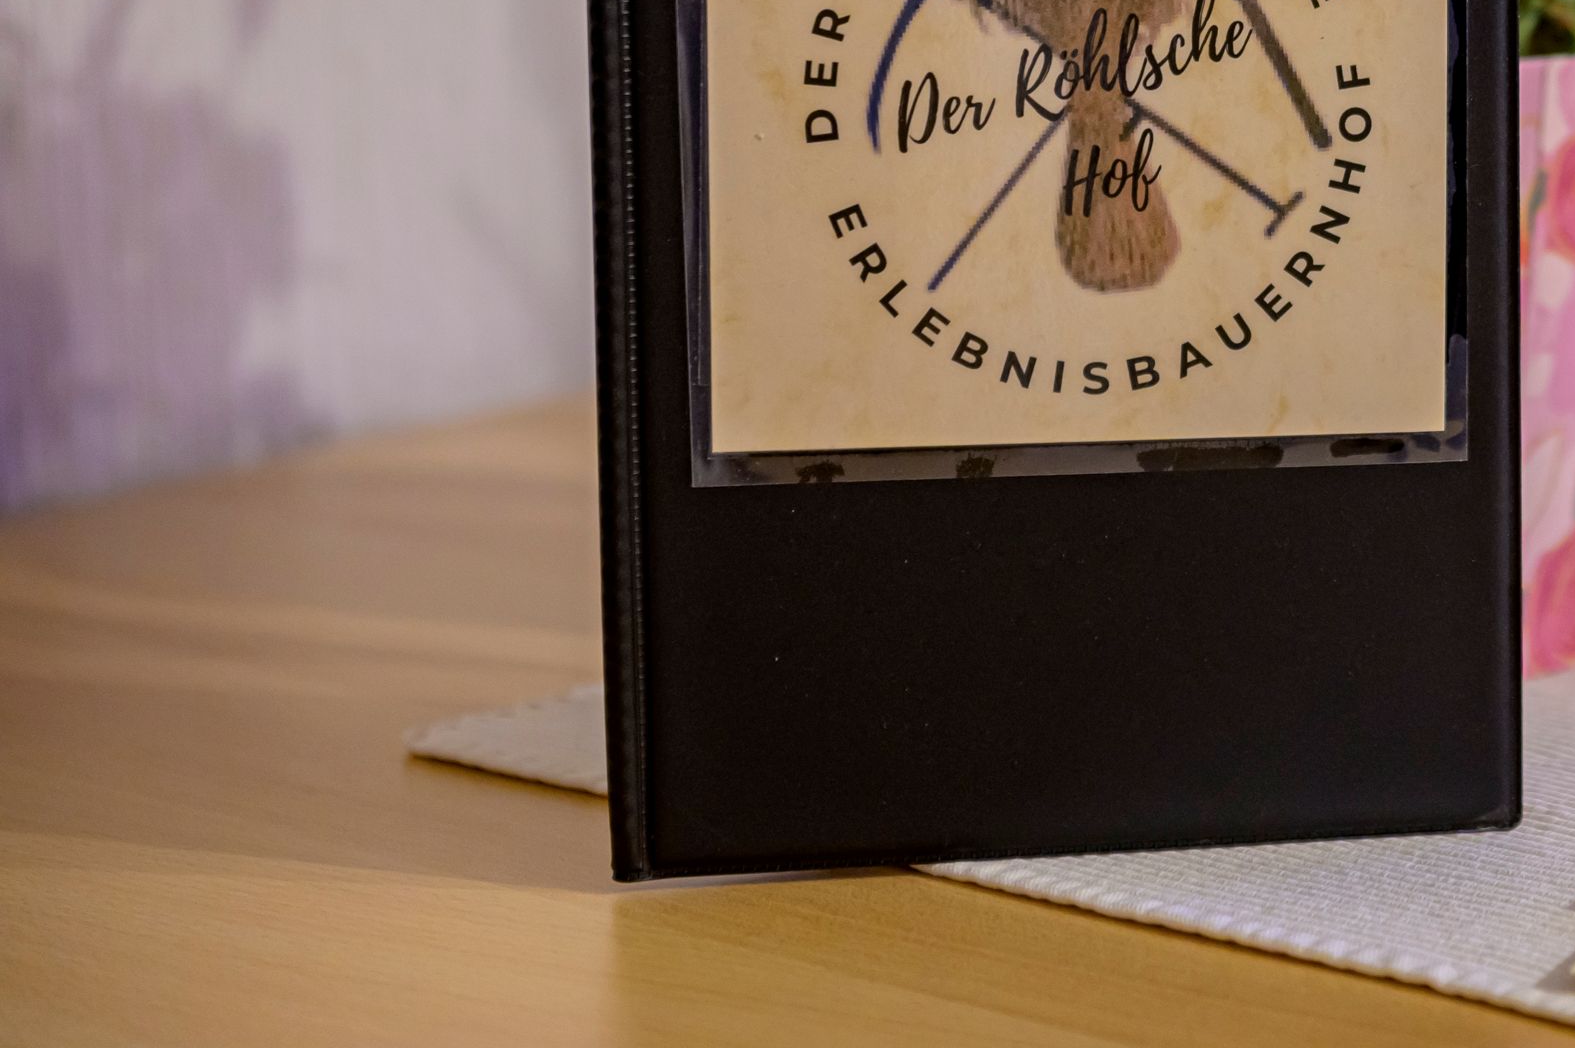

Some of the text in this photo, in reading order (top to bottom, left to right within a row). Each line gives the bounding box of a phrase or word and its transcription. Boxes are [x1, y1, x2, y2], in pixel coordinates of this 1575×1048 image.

[803, 8, 851, 144] DER
[897, 71, 996, 154] Der
[1063, 127, 1162, 218] Hof
[828, 64, 1373, 395] ERLEBNISBAUERNHOF
